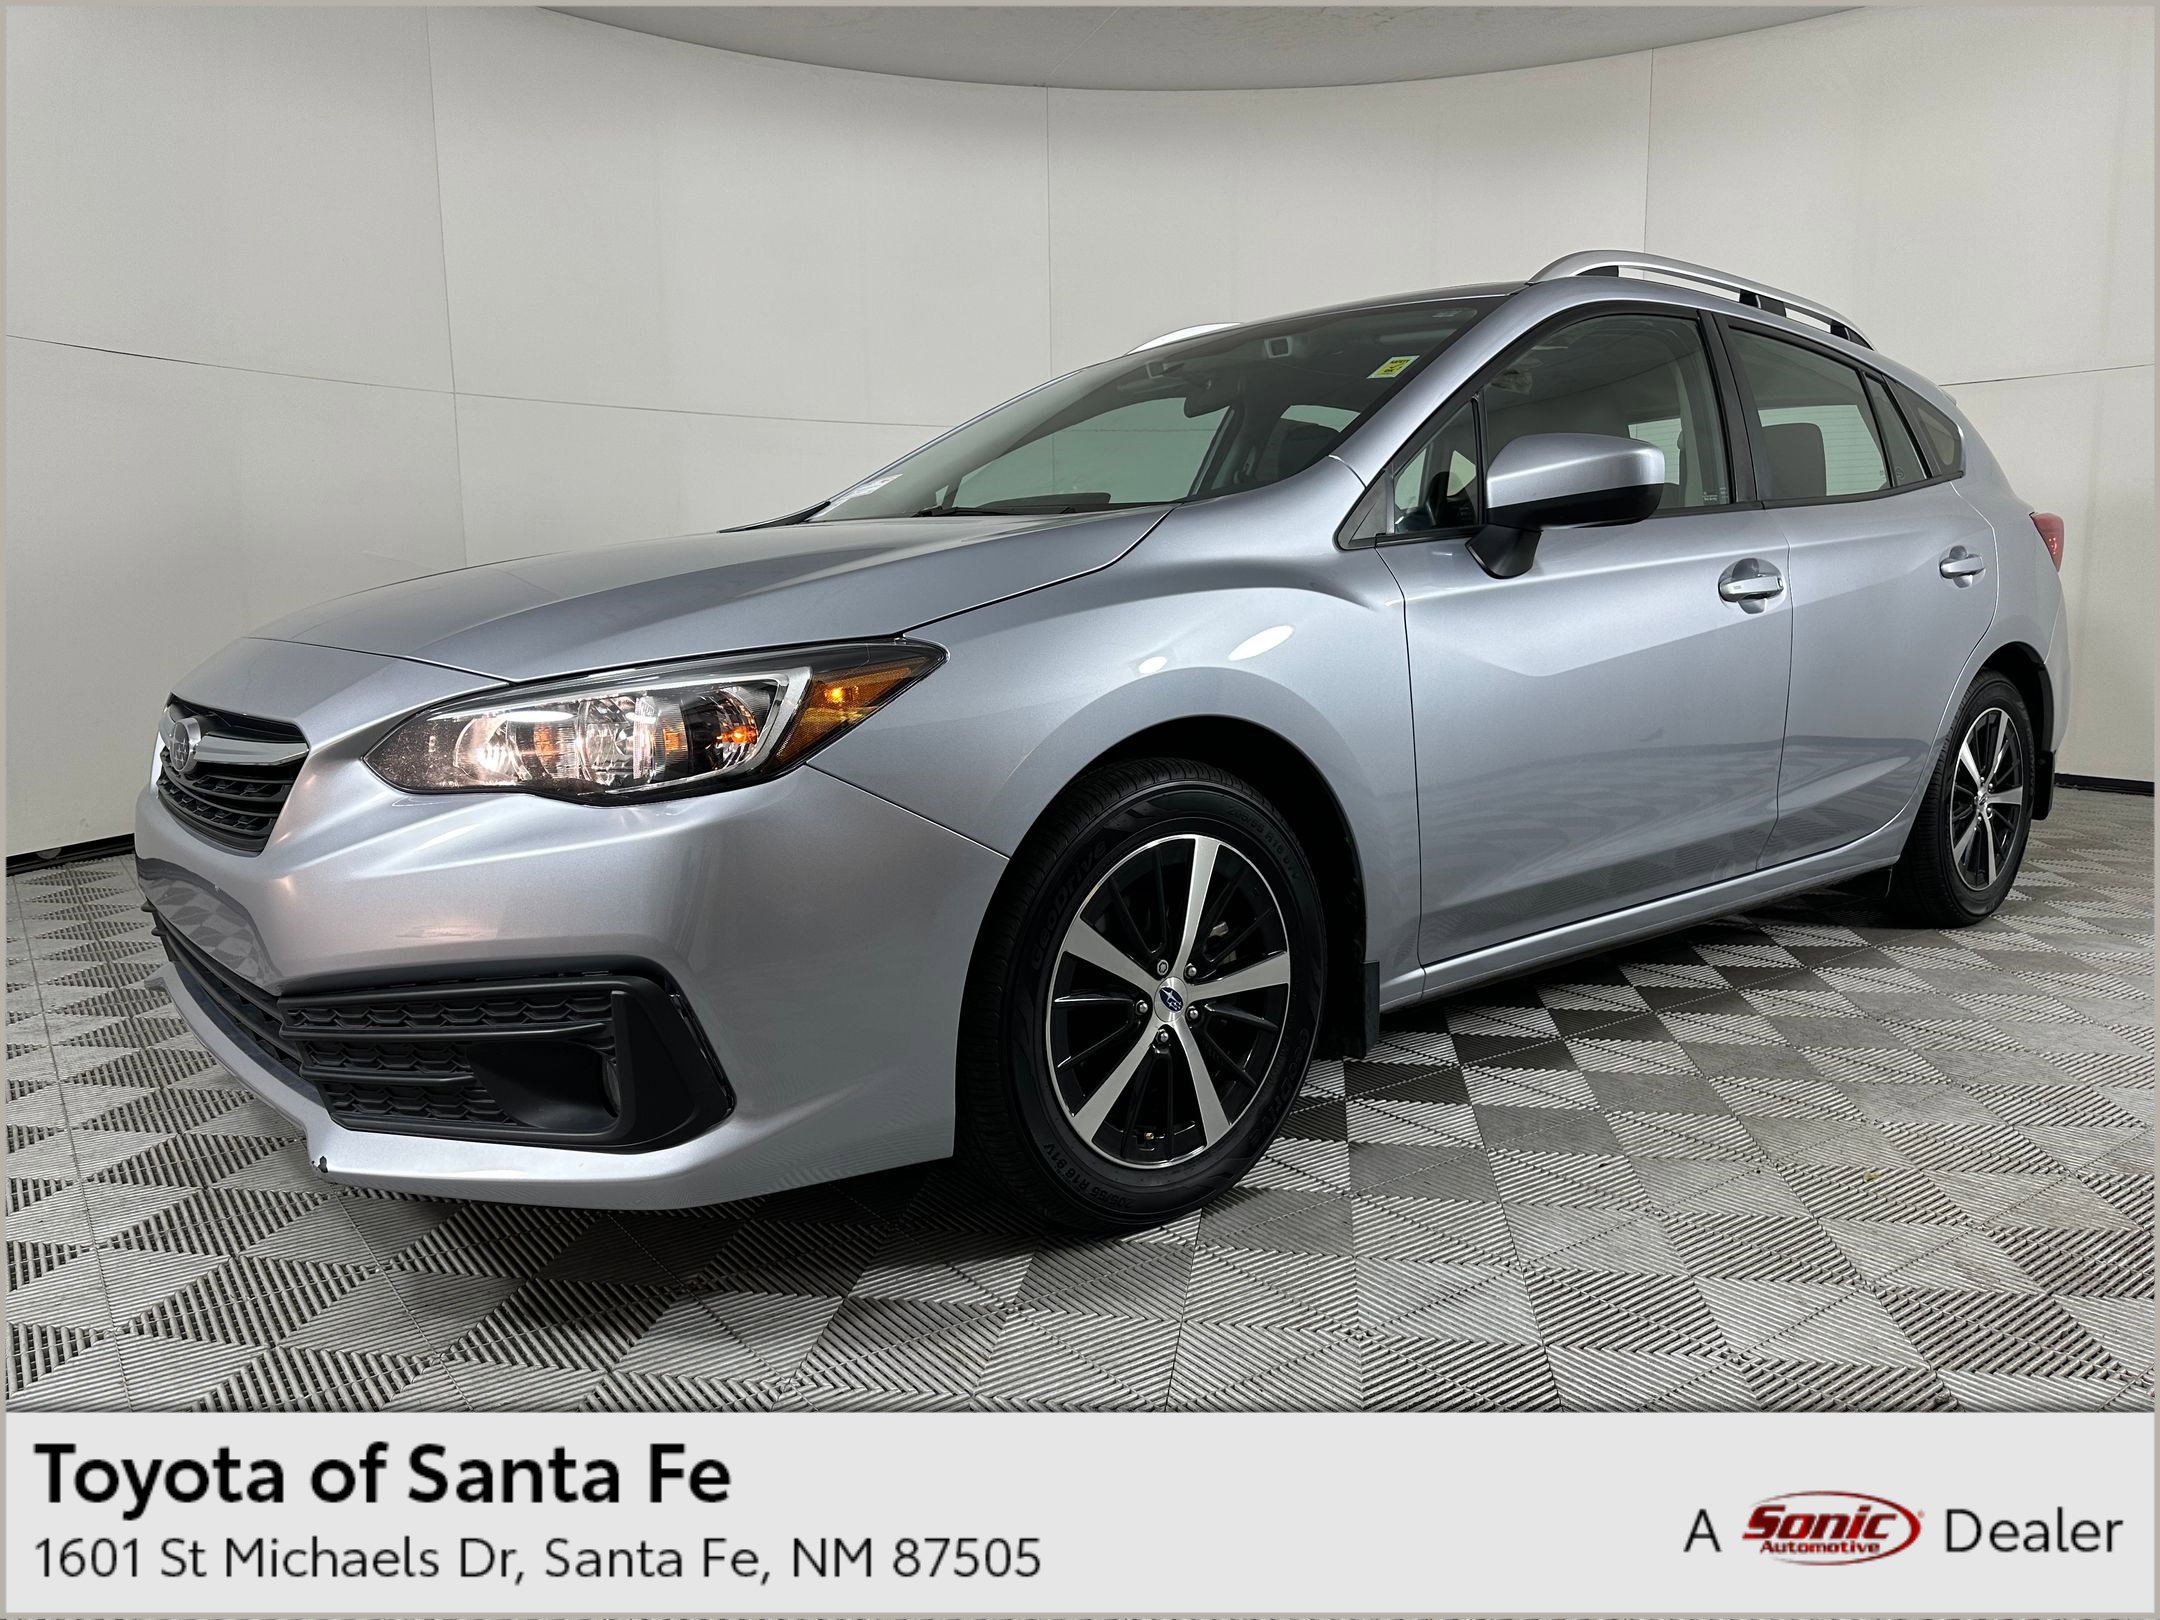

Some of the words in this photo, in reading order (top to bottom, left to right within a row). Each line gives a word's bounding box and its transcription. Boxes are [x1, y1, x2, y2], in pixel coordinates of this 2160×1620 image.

[1042, 1143, 1068, 1169] 91V
[1065, 1168, 1090, 1191] R16
[1088, 1186, 1135, 1209] 205/55
